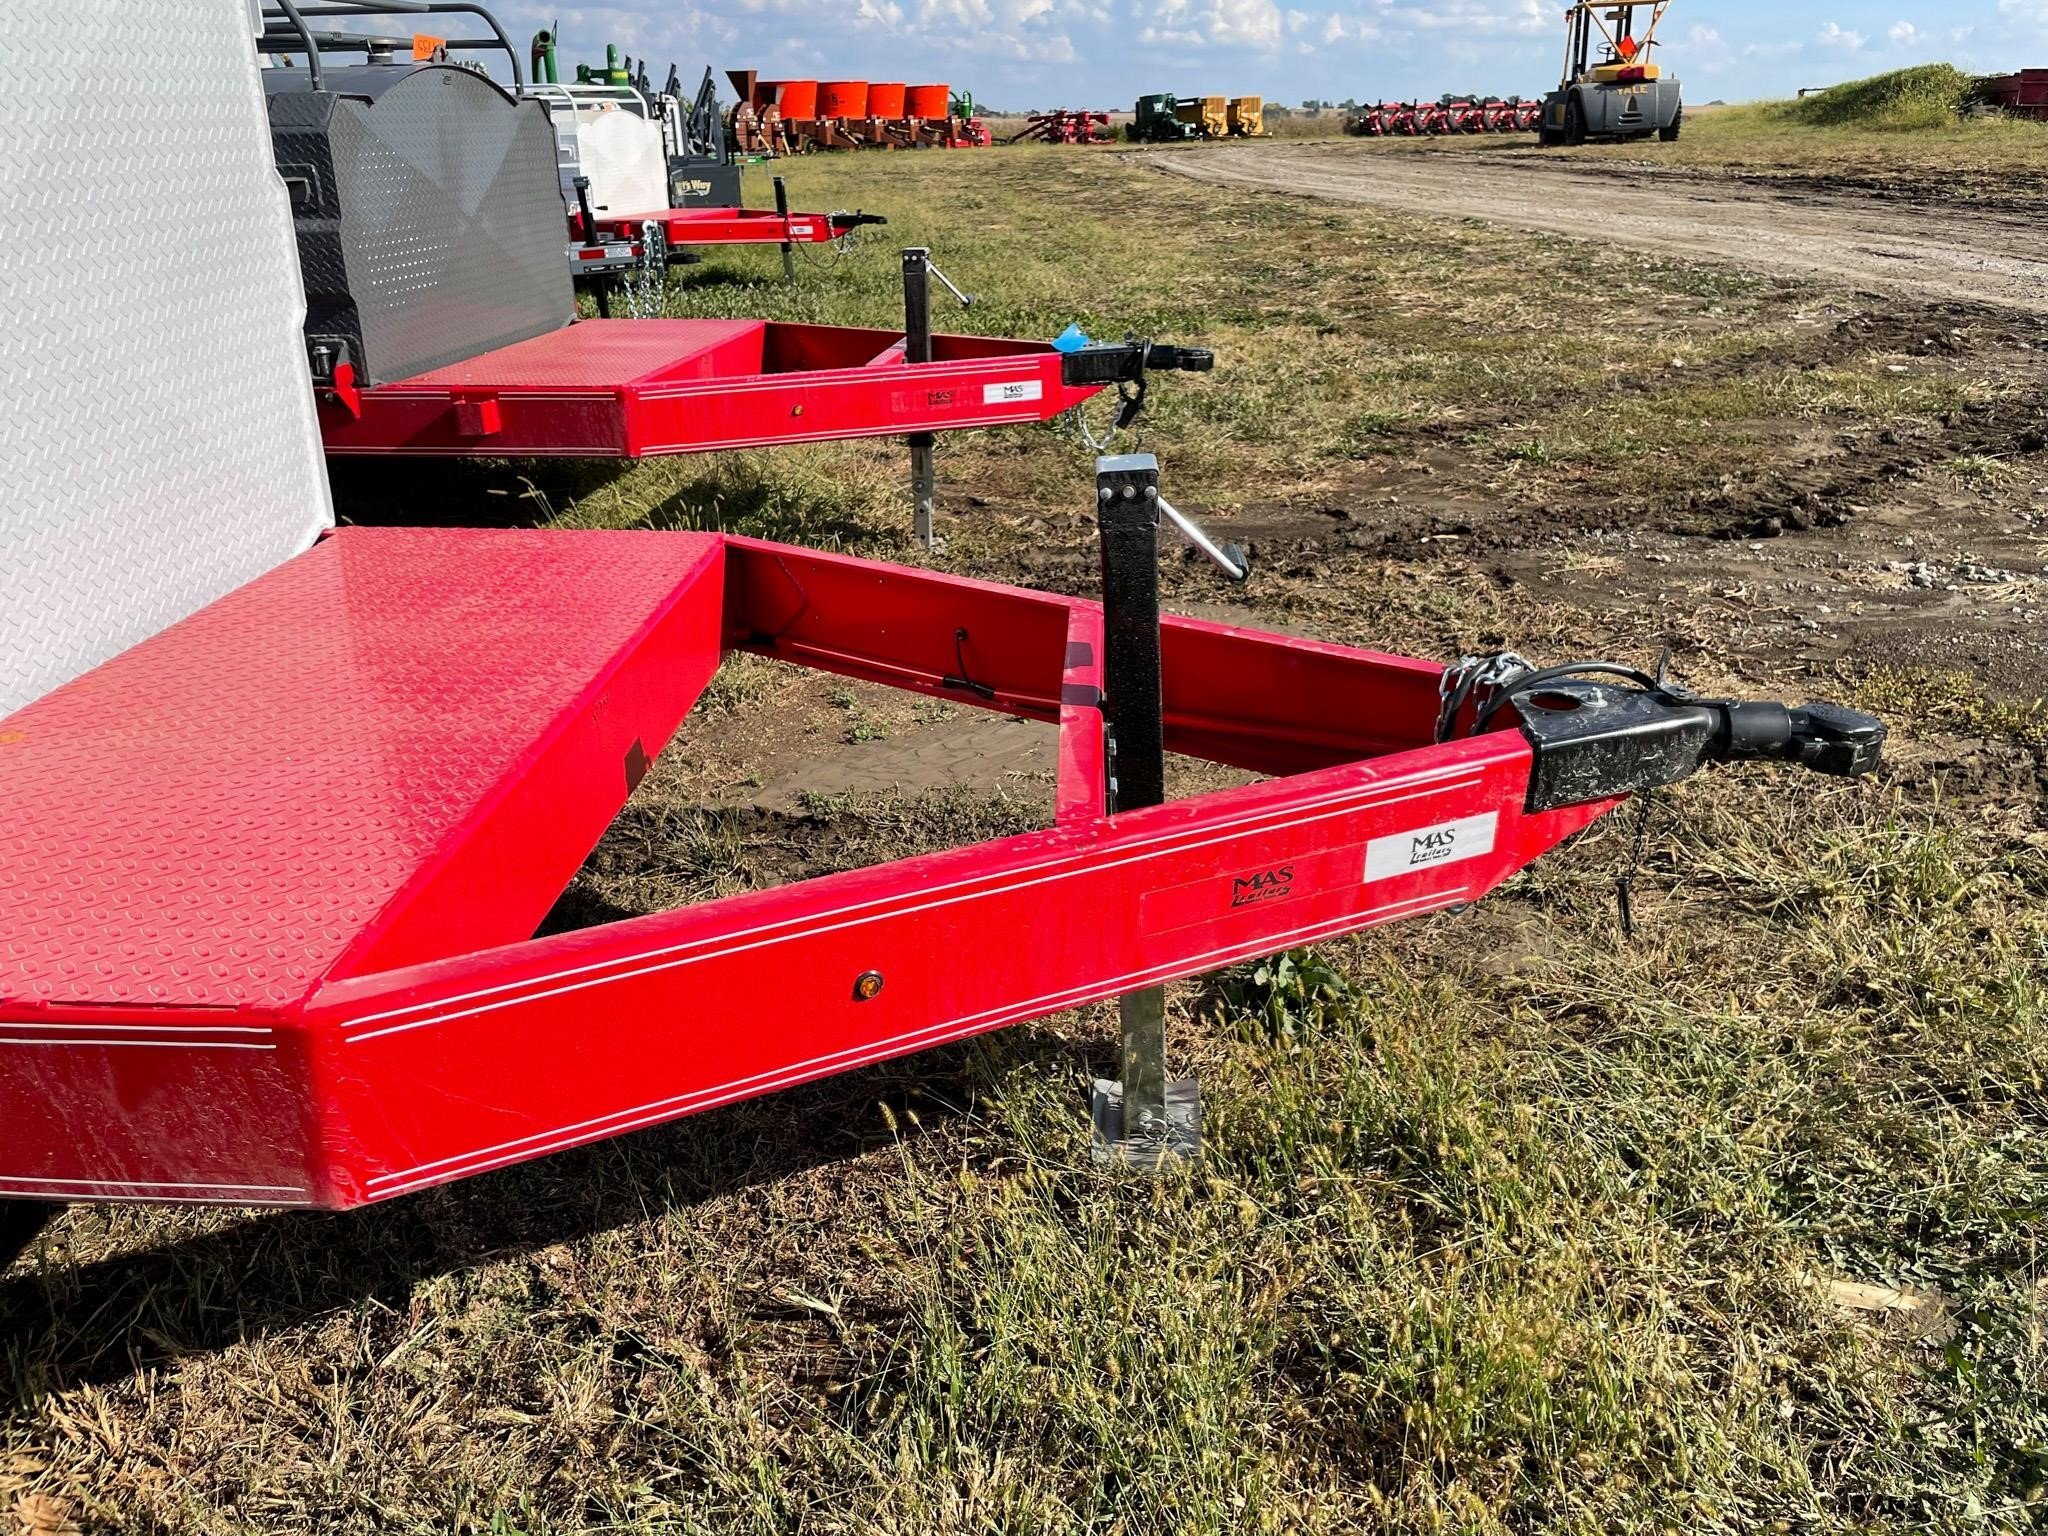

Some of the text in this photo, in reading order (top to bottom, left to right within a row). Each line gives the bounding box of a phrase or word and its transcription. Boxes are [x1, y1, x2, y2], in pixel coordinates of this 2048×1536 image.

[1616, 83, 1649, 96] YALE
[1411, 828, 1456, 853] MAS
[1232, 865, 1294, 895] MAS
